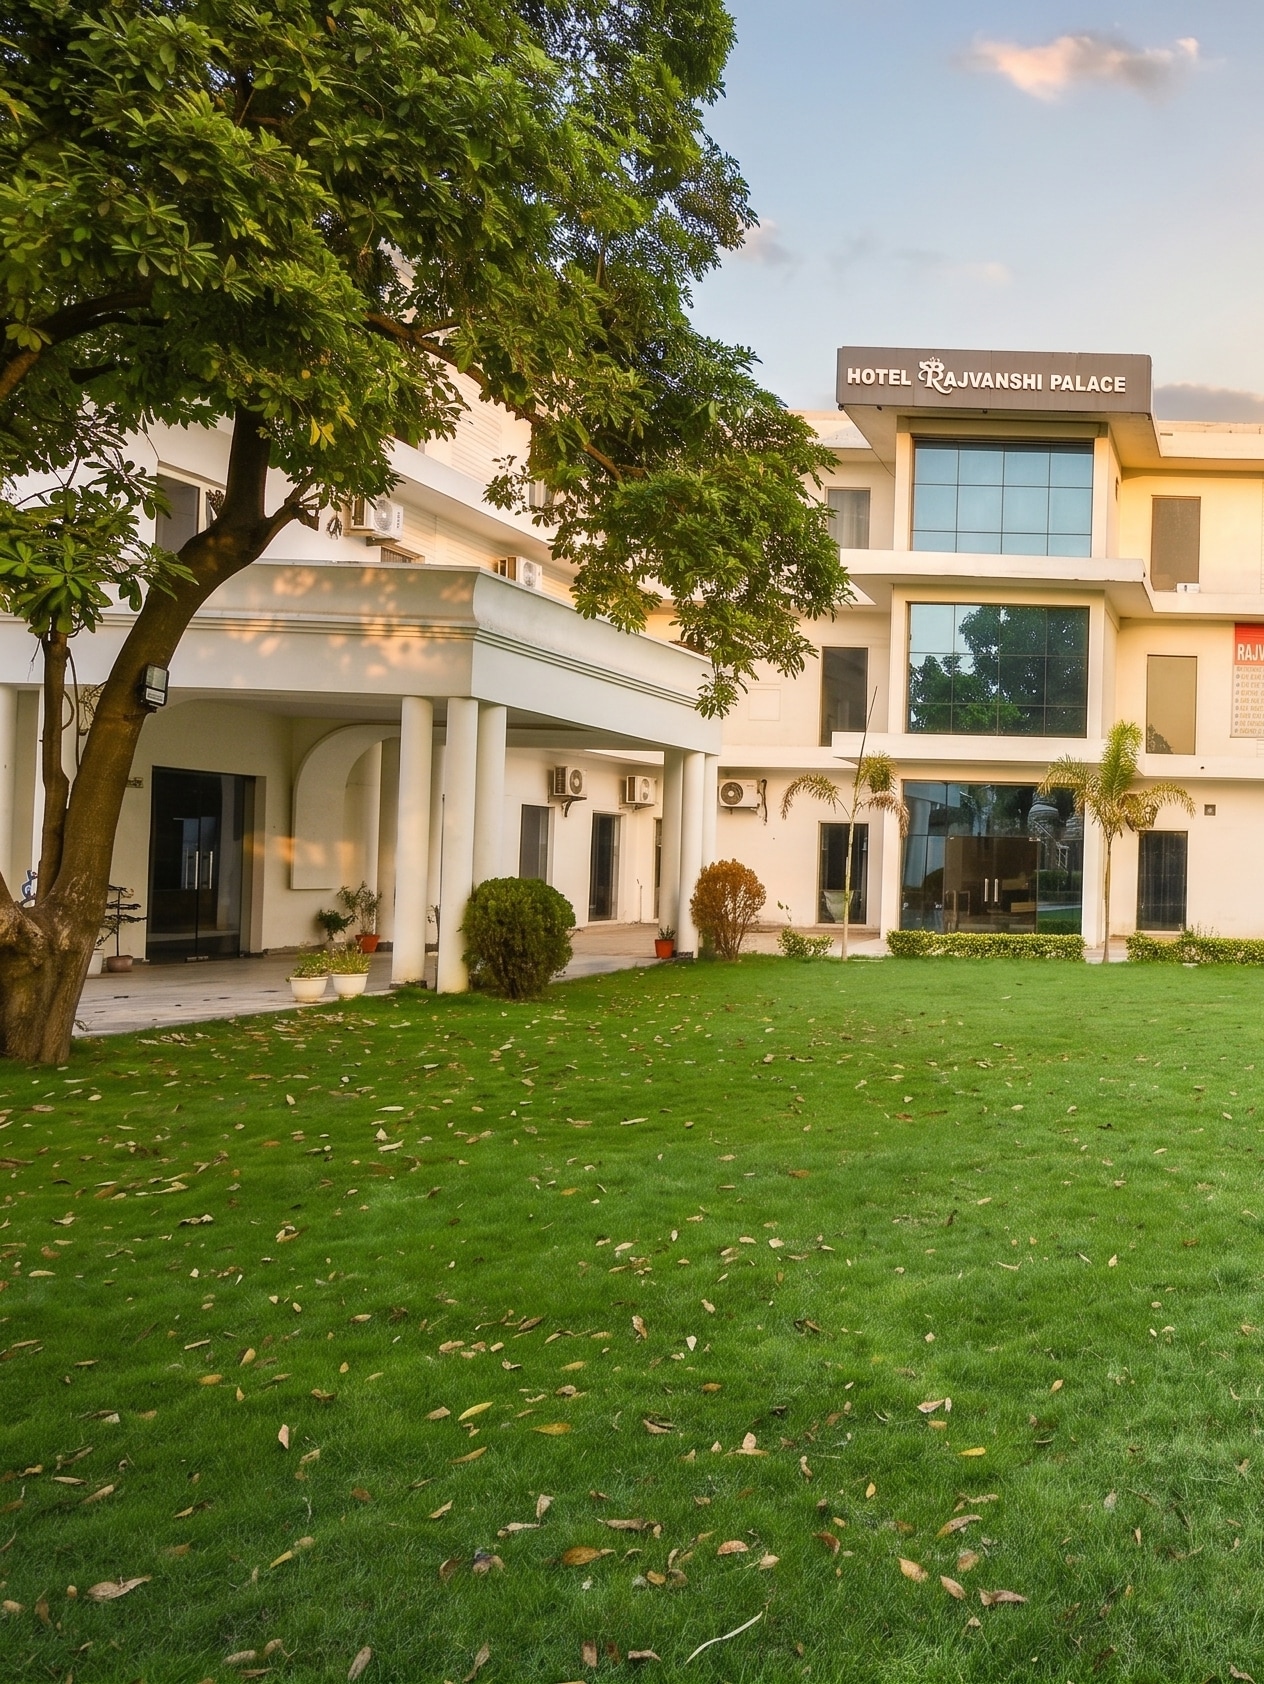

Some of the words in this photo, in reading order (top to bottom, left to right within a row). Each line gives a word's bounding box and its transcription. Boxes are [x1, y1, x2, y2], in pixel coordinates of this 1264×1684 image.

[846, 367, 912, 387] HOTEL
[918, 358, 1043, 395] RAJVANSHI
[1049, 373, 1127, 394] PALACE
